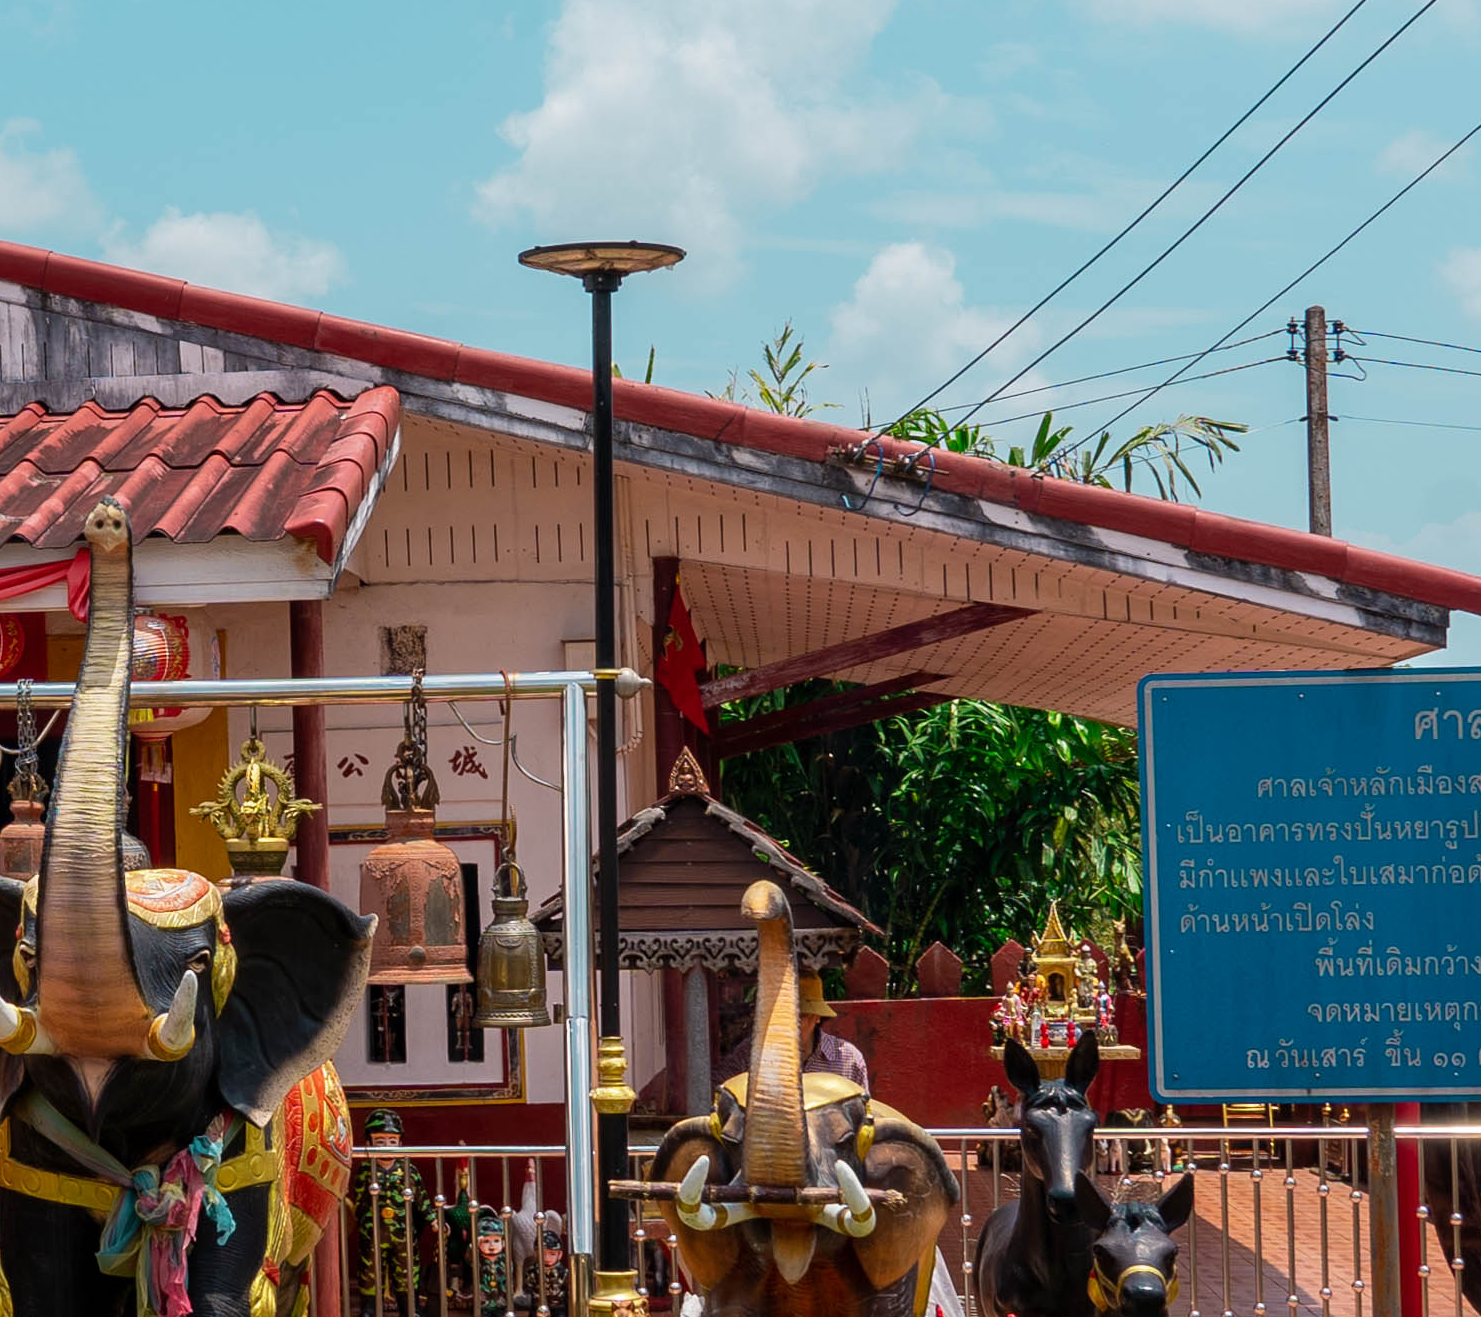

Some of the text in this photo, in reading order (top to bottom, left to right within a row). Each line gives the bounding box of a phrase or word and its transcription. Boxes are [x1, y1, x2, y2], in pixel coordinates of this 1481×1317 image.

[1180, 901, 1374, 934] ด้านหน้าเปิดโล่ง
[1384, 1028, 1421, 1067] ขึ้น
[1433, 1051, 1466, 1068] ๑๑
